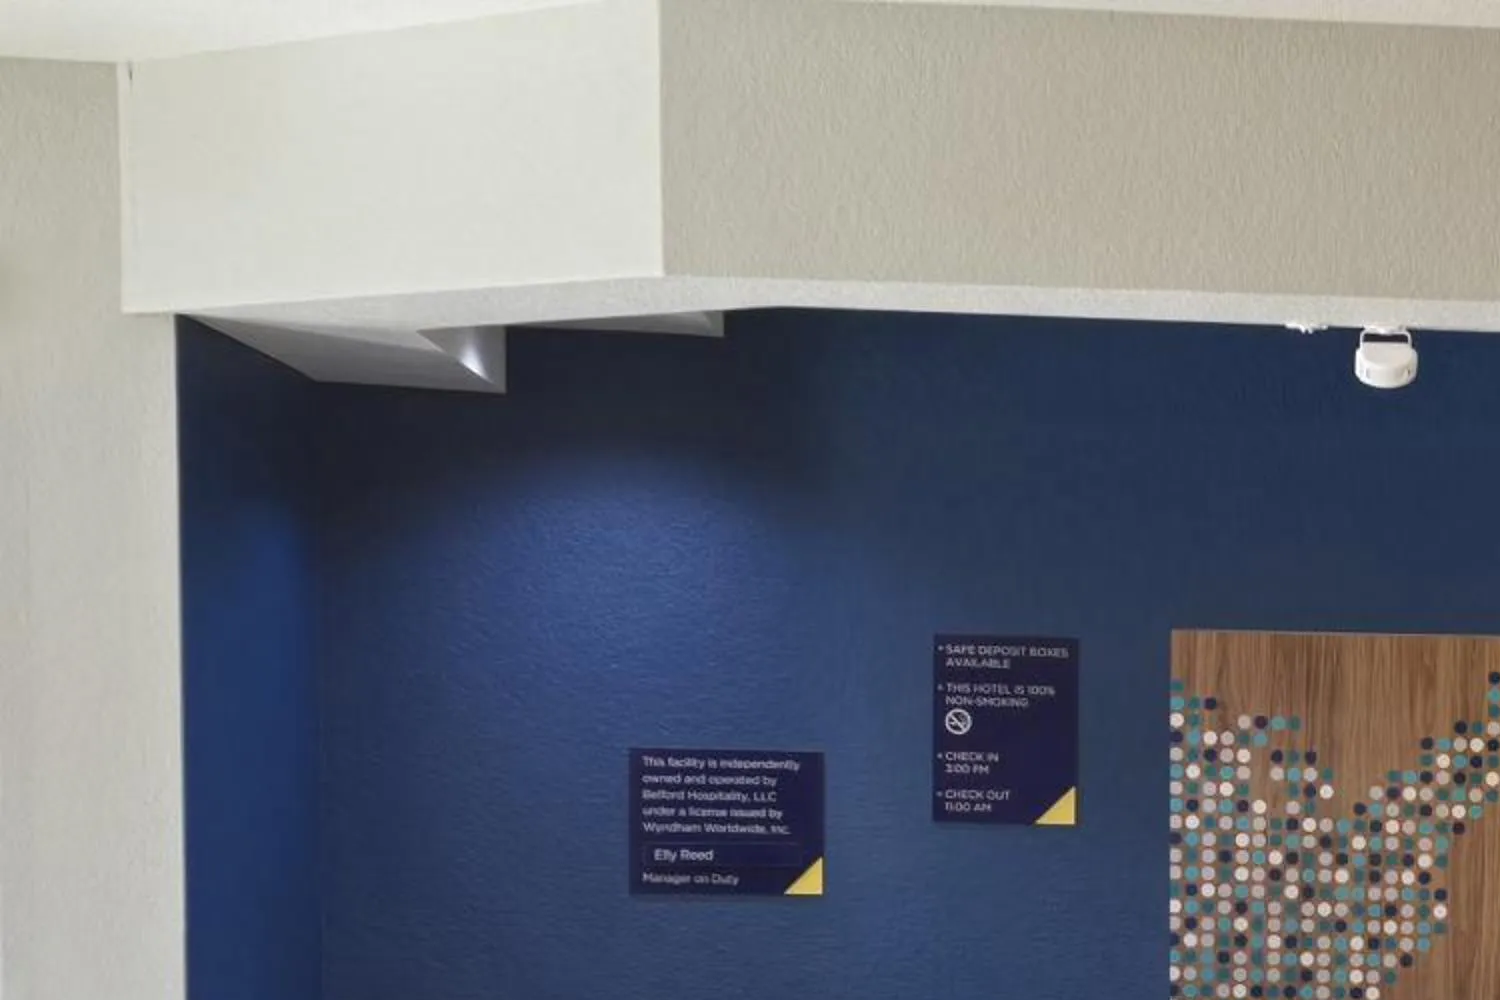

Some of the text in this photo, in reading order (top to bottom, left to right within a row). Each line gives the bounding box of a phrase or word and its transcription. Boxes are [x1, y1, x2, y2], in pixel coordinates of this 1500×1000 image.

[945, 644, 1070, 659] SAFE DEPOSIT BOXES
[945, 658, 1011, 670] AVAILABLE
[946, 683, 972, 694] THIS
[973, 683, 1011, 695] HOTEL
[1013, 684, 1025, 696] IS
[945, 751, 1000, 763] CHECK IN
[641, 755, 800, 773] This facility is independently
[972, 763, 990, 775] PM
[641, 773, 777, 787] owned and operated by
[753, 791, 777, 802] LLC
[944, 788, 1011, 801] CHECK OUT
[641, 806, 676, 817] under
[678, 808, 687, 817] a
[768, 808, 783, 821] by
[973, 802, 993, 813] AM
[641, 821, 702, 834] Wyndham
[679, 849, 715, 861] Reed
[641, 871, 739, 886] Manager on Duty
